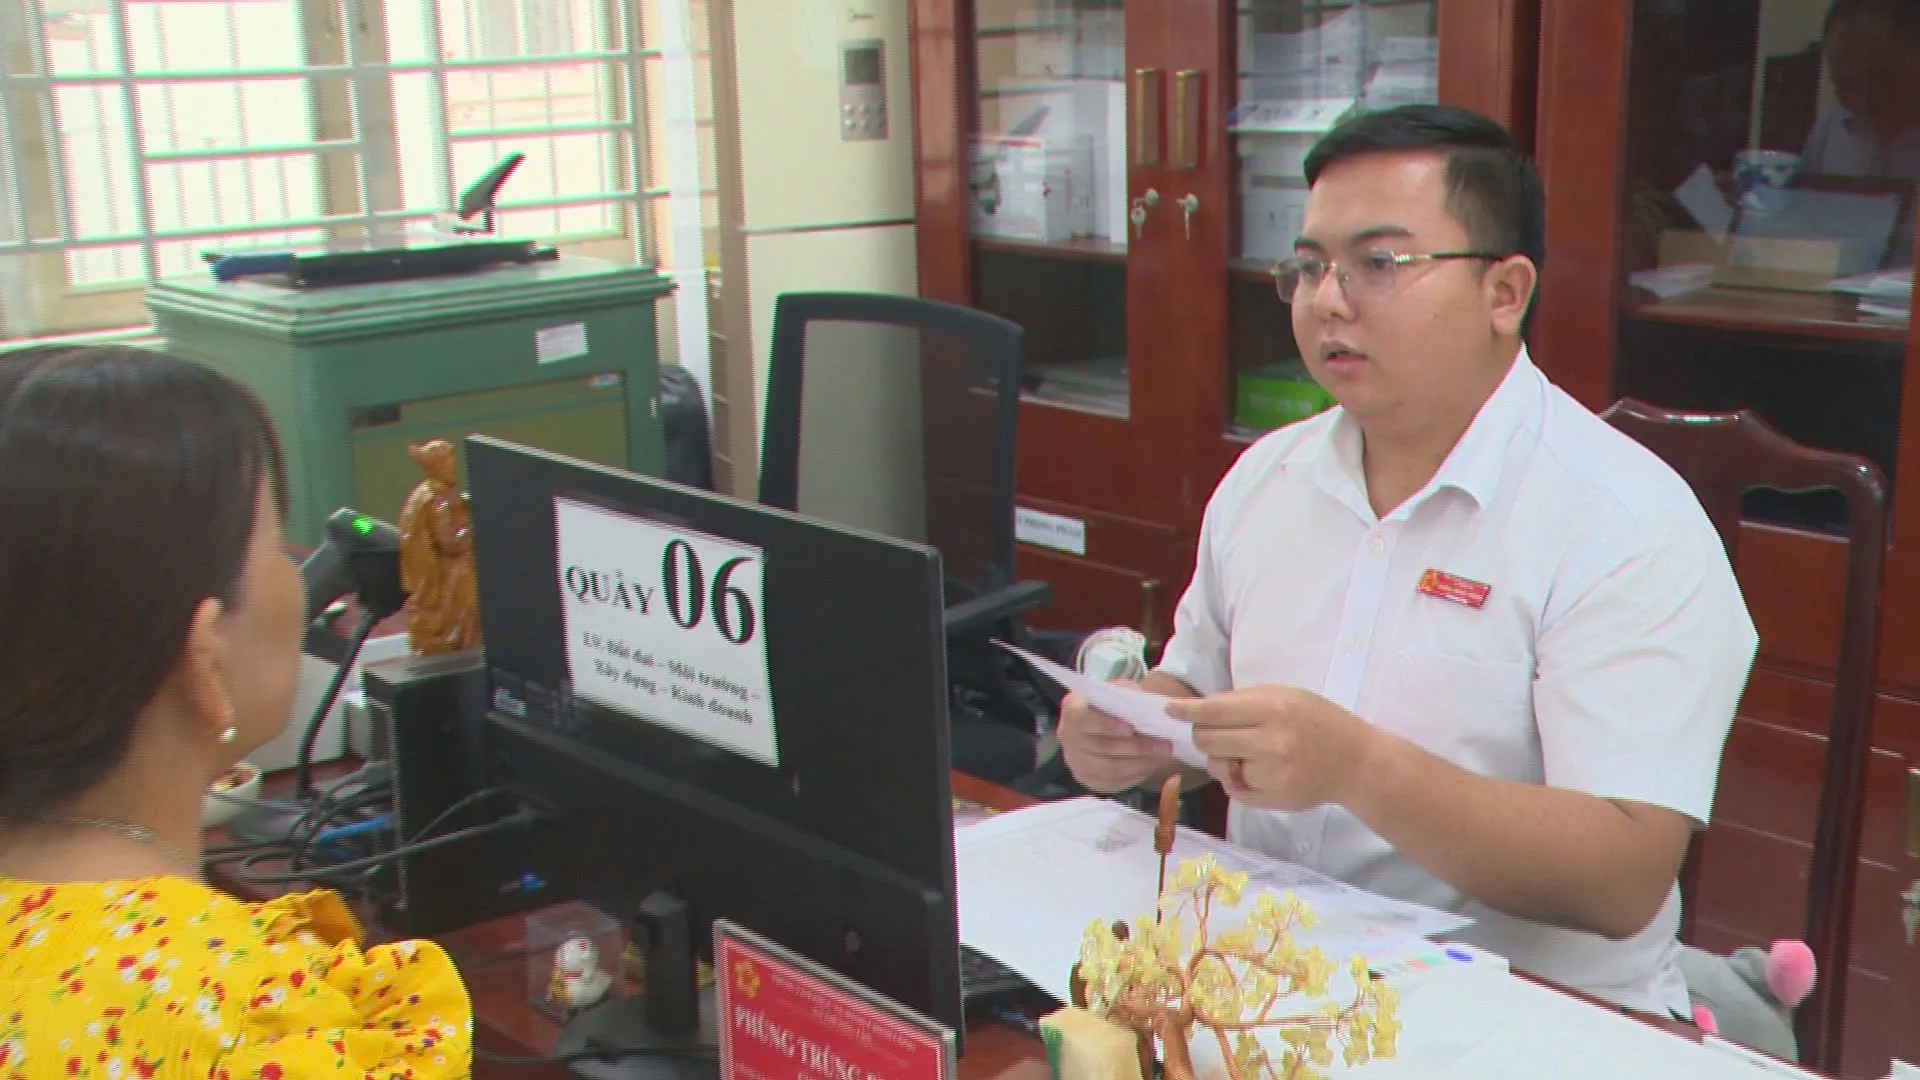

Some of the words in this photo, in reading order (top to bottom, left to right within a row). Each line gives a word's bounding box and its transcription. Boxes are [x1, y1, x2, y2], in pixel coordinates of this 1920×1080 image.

[662, 538, 755, 645] 06
[593, 658, 620, 682] Xây
[622, 669, 657, 696] dựng
[671, 684, 705, 710] Kinh
[707, 698, 753, 725] doanh
[632, 648, 655, 668] đai
[668, 659, 696, 682] Môi
[698, 670, 749, 701] trường
